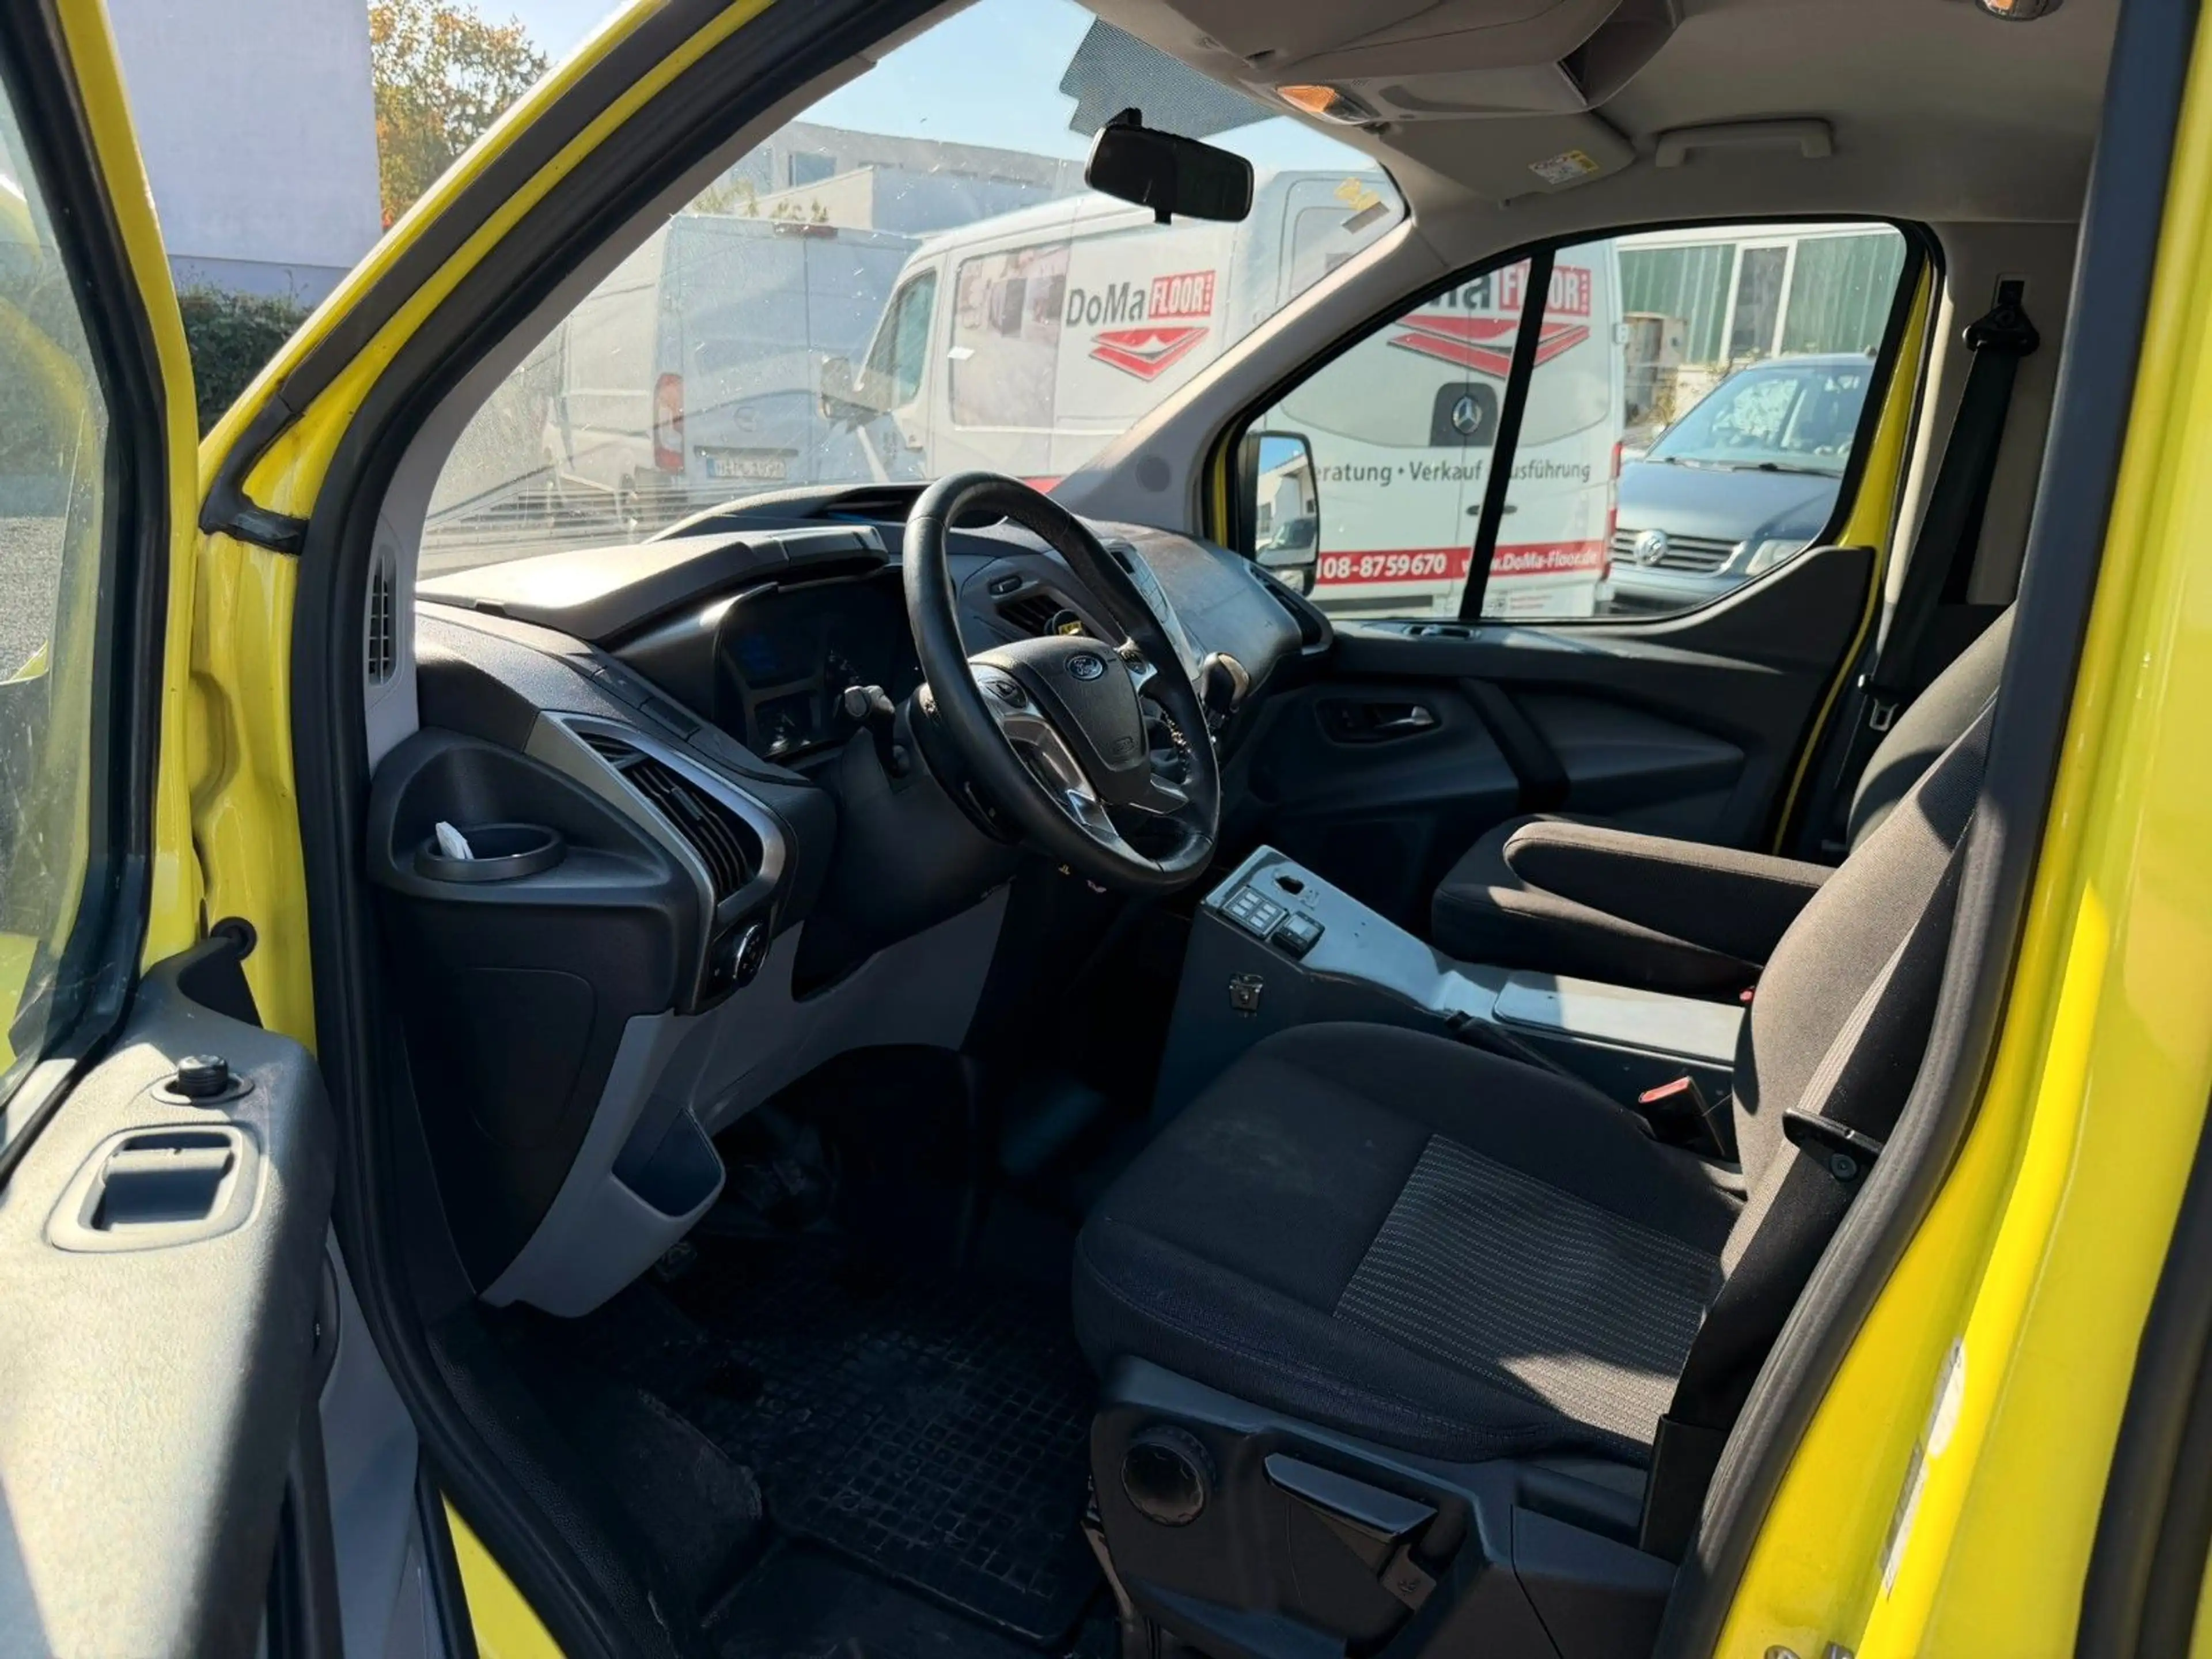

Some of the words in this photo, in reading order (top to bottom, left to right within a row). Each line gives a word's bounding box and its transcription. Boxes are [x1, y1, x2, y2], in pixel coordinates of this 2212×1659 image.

[1066, 282, 1146, 327] DoMa
[1151, 276, 1204, 315] FLOOR
[1502, 263, 1578, 311] FLOR
[1315, 463, 1392, 487] eratung
[1410, 460, 1482, 481] Verkauf
[1510, 459, 1591, 483] usführung
[1316, 553, 1448, 579] 108-8759670
